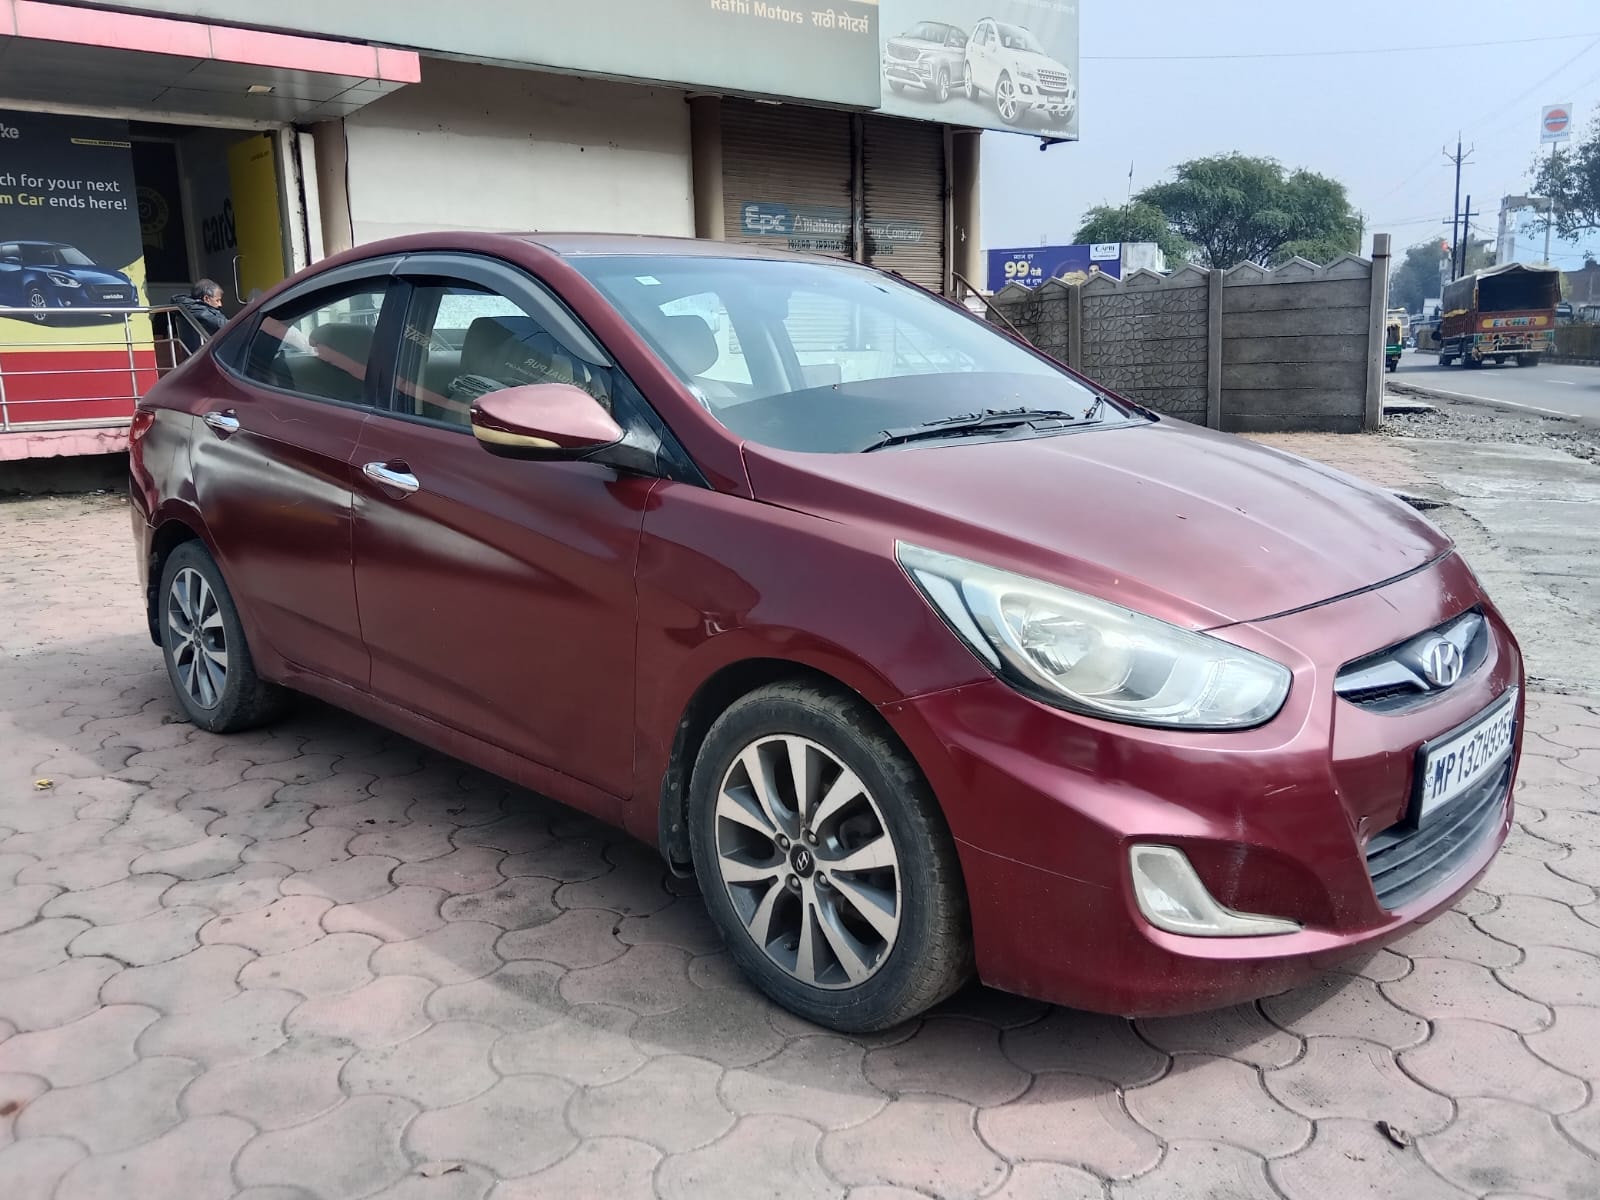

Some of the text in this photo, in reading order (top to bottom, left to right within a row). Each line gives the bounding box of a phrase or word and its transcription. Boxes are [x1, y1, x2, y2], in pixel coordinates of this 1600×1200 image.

[711, 0, 804, 24] Rathi Motors
[811, 8, 870, 33] राठी मोटर्स
[21, 174, 44, 188] for
[48, 178, 82, 191] your
[87, 180, 120, 192] next
[18, 193, 45, 206] Car
[49, 195, 86, 208] ends
[89, 195, 128, 210] here!
